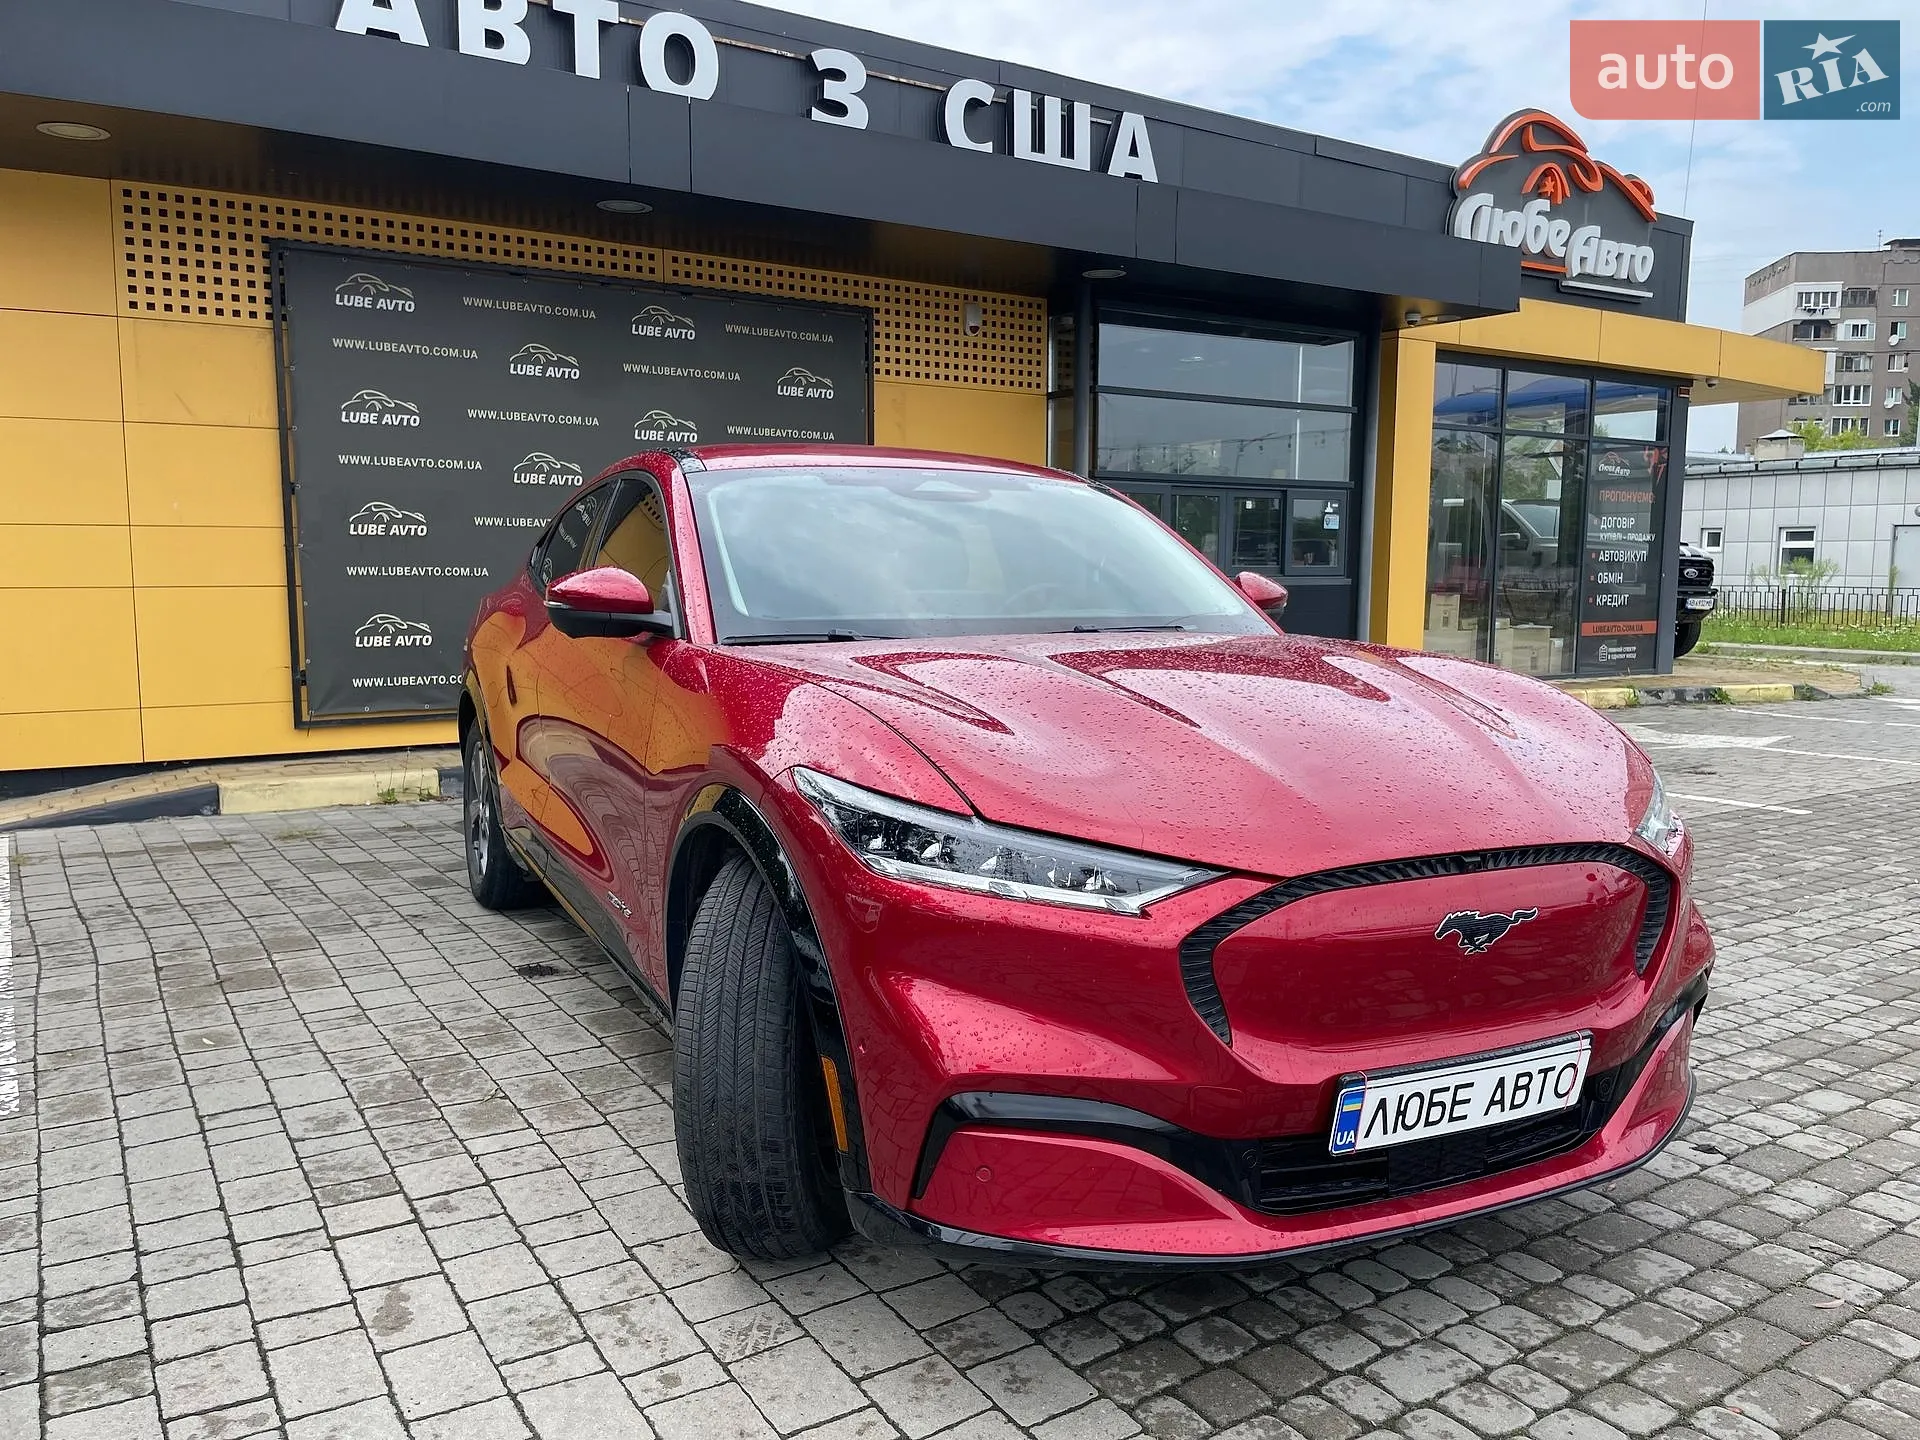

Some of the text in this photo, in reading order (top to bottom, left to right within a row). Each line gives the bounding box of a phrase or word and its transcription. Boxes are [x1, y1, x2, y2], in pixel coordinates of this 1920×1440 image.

[945, 79, 1158, 183] США
[336, 294, 414, 312] LUBE AVTO
[464, 297, 595, 318] WWW.LUBEAVTO.COM.UA
[632, 324, 695, 339] LUBE AVTO
[726, 324, 833, 342] WWW.LUBEAVTO.COM.UA
[333, 338, 478, 359] WWW.LUBEAVTO.COM.UA
[510, 364, 579, 379] LUBE AVTO
[624, 364, 740, 380] WWW.LUBEAVTO.COM.UA
[778, 385, 833, 399] LUBE AVTO
[341, 411, 420, 426] LUBE AVTO
[468, 409, 599, 426] WWW.LUBEAVTO.COM.UA
[635, 429, 697, 442] LUBE AVTO
[727, 426, 834, 440] WWW.LUBEAVTO.COM.UA
[338, 455, 482, 470] WWW.LUBEAVTO.COM.UA
[514, 472, 583, 486] LUBE AVTO
[350, 523, 427, 536] LUBE AVTO
[1600, 517, 1635, 530] ДОГОВІР
[1599, 550, 1647, 562] АВТОВИКУП
[347, 567, 488, 576] WWW.LUBEAVTO.COM.UA
[1597, 572, 1623, 584] ОБМІН
[1596, 594, 1629, 607] КРЕДИТ
[355, 635, 432, 647] LUBE AVTO
[1364, 1062, 1578, 1138] ЛЮБЕ АВТО
[1336, 1130, 1355, 1146] UA
